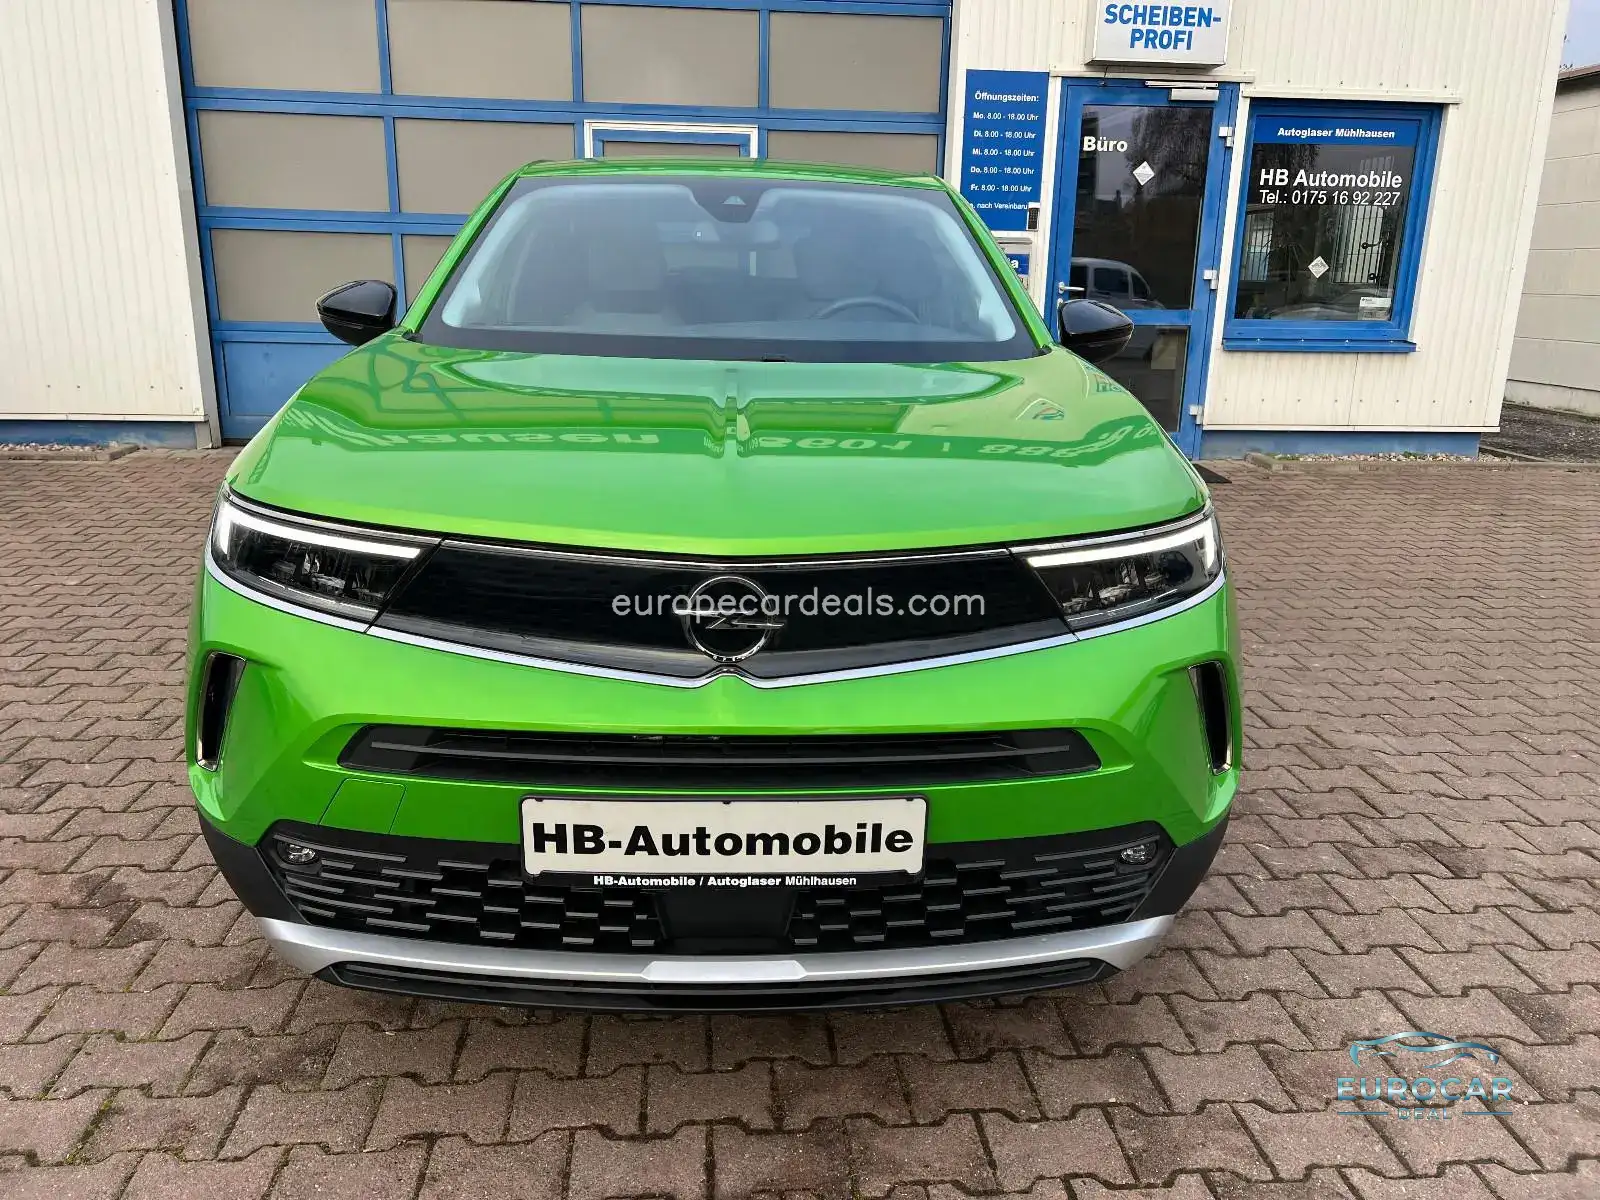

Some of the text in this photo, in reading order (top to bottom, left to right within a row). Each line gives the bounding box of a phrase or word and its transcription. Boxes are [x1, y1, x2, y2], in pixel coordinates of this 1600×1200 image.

[1104, 4, 1221, 27] SCHEIBEN-
[1130, 29, 1193, 50] PROFI
[975, 91, 1040, 102] Öffnungszeiten:
[1007, 113, 1025, 121] 18.00
[1005, 131, 1022, 139] 18.00
[1277, 128, 1395, 139] Autoglaser Mühlhausen
[1083, 136, 1128, 152] Büro
[1004, 149, 1022, 157] 18.00
[1259, 168, 1403, 188] HB Automobile
[981, 184, 996, 192] 8.00
[1020, 185, 1033, 193] Uhr
[1260, 190, 1401, 206] Tel.: 0175 16 92 227
[994, 202, 1028, 210] Vereinbaru
[533, 823, 914, 857] HB-Automobile
[594, 875, 857, 888] HB-Automobile / Autoglaser Mühlhausen
